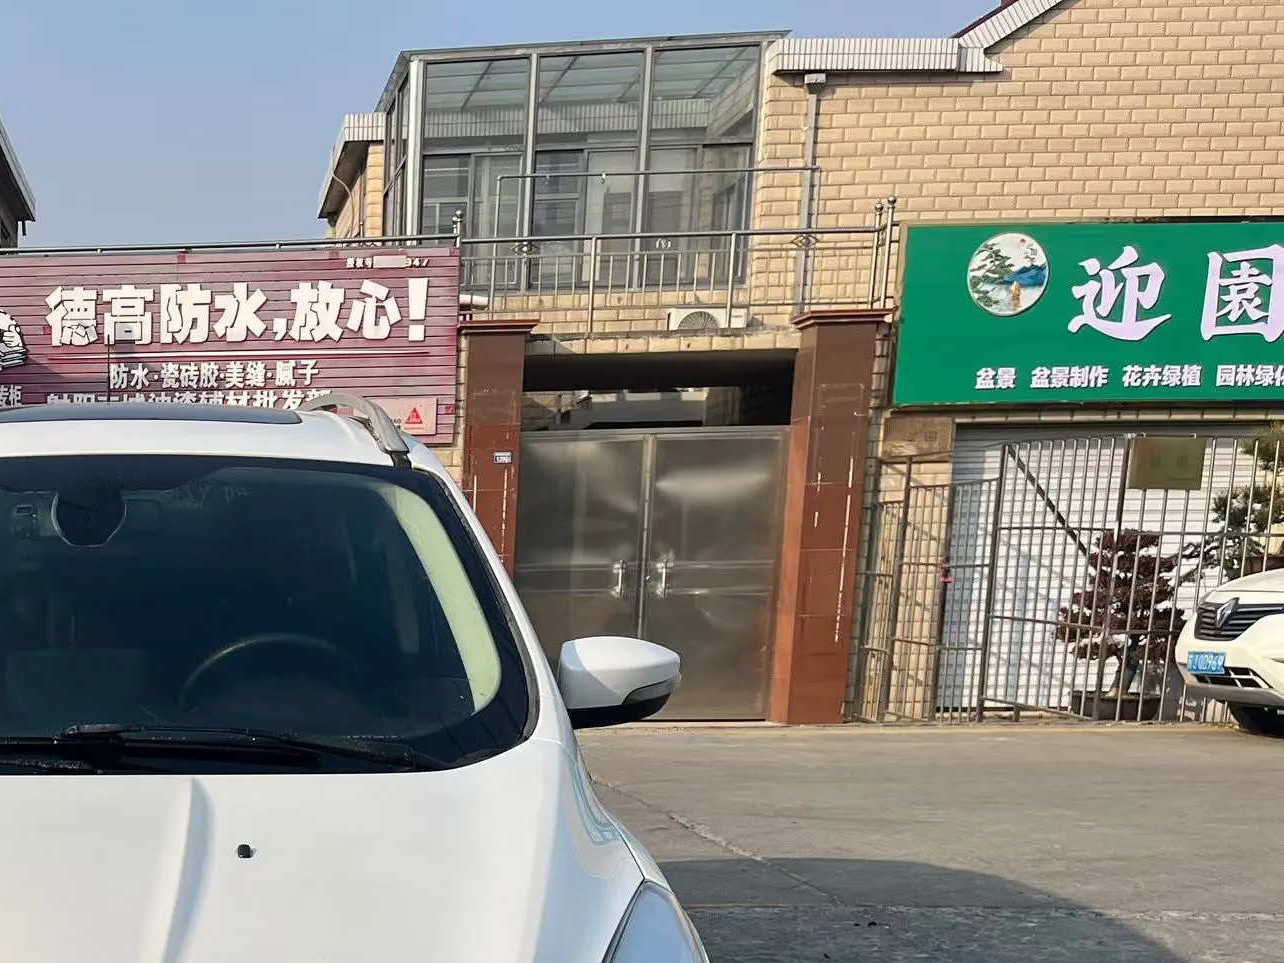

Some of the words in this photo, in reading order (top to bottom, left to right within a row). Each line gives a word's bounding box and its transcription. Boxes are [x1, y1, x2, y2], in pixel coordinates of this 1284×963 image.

[975, 367, 1016, 389] 盆景
[1030, 366, 1109, 388] 盆景制作
[1122, 365, 1202, 387] 花卉绿植
